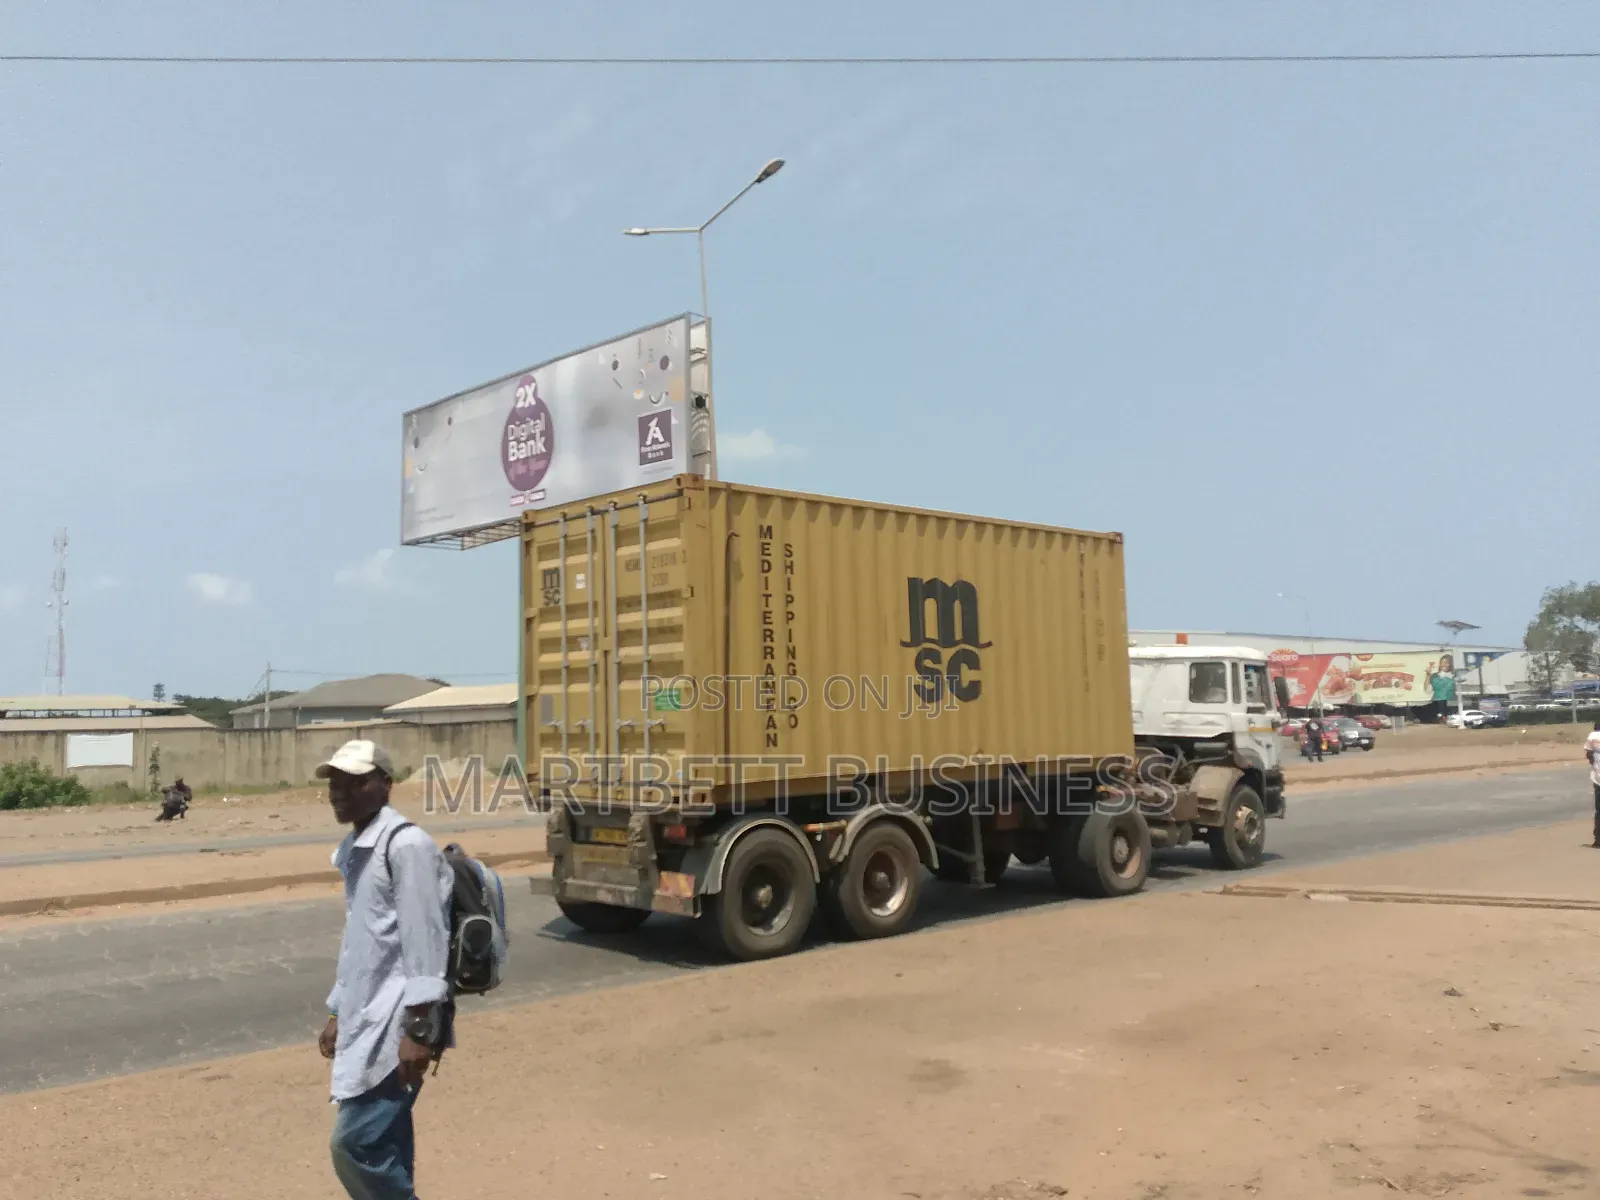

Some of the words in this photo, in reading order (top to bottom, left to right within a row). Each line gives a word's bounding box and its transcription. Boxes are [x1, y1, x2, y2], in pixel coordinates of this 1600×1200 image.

[516, 382, 537, 409] 2X
[507, 412, 546, 443] Digital
[507, 431, 547, 462] Bank
[784, 543, 798, 677] SHIPPING
[759, 524, 779, 748] MEDITERRANEAN
